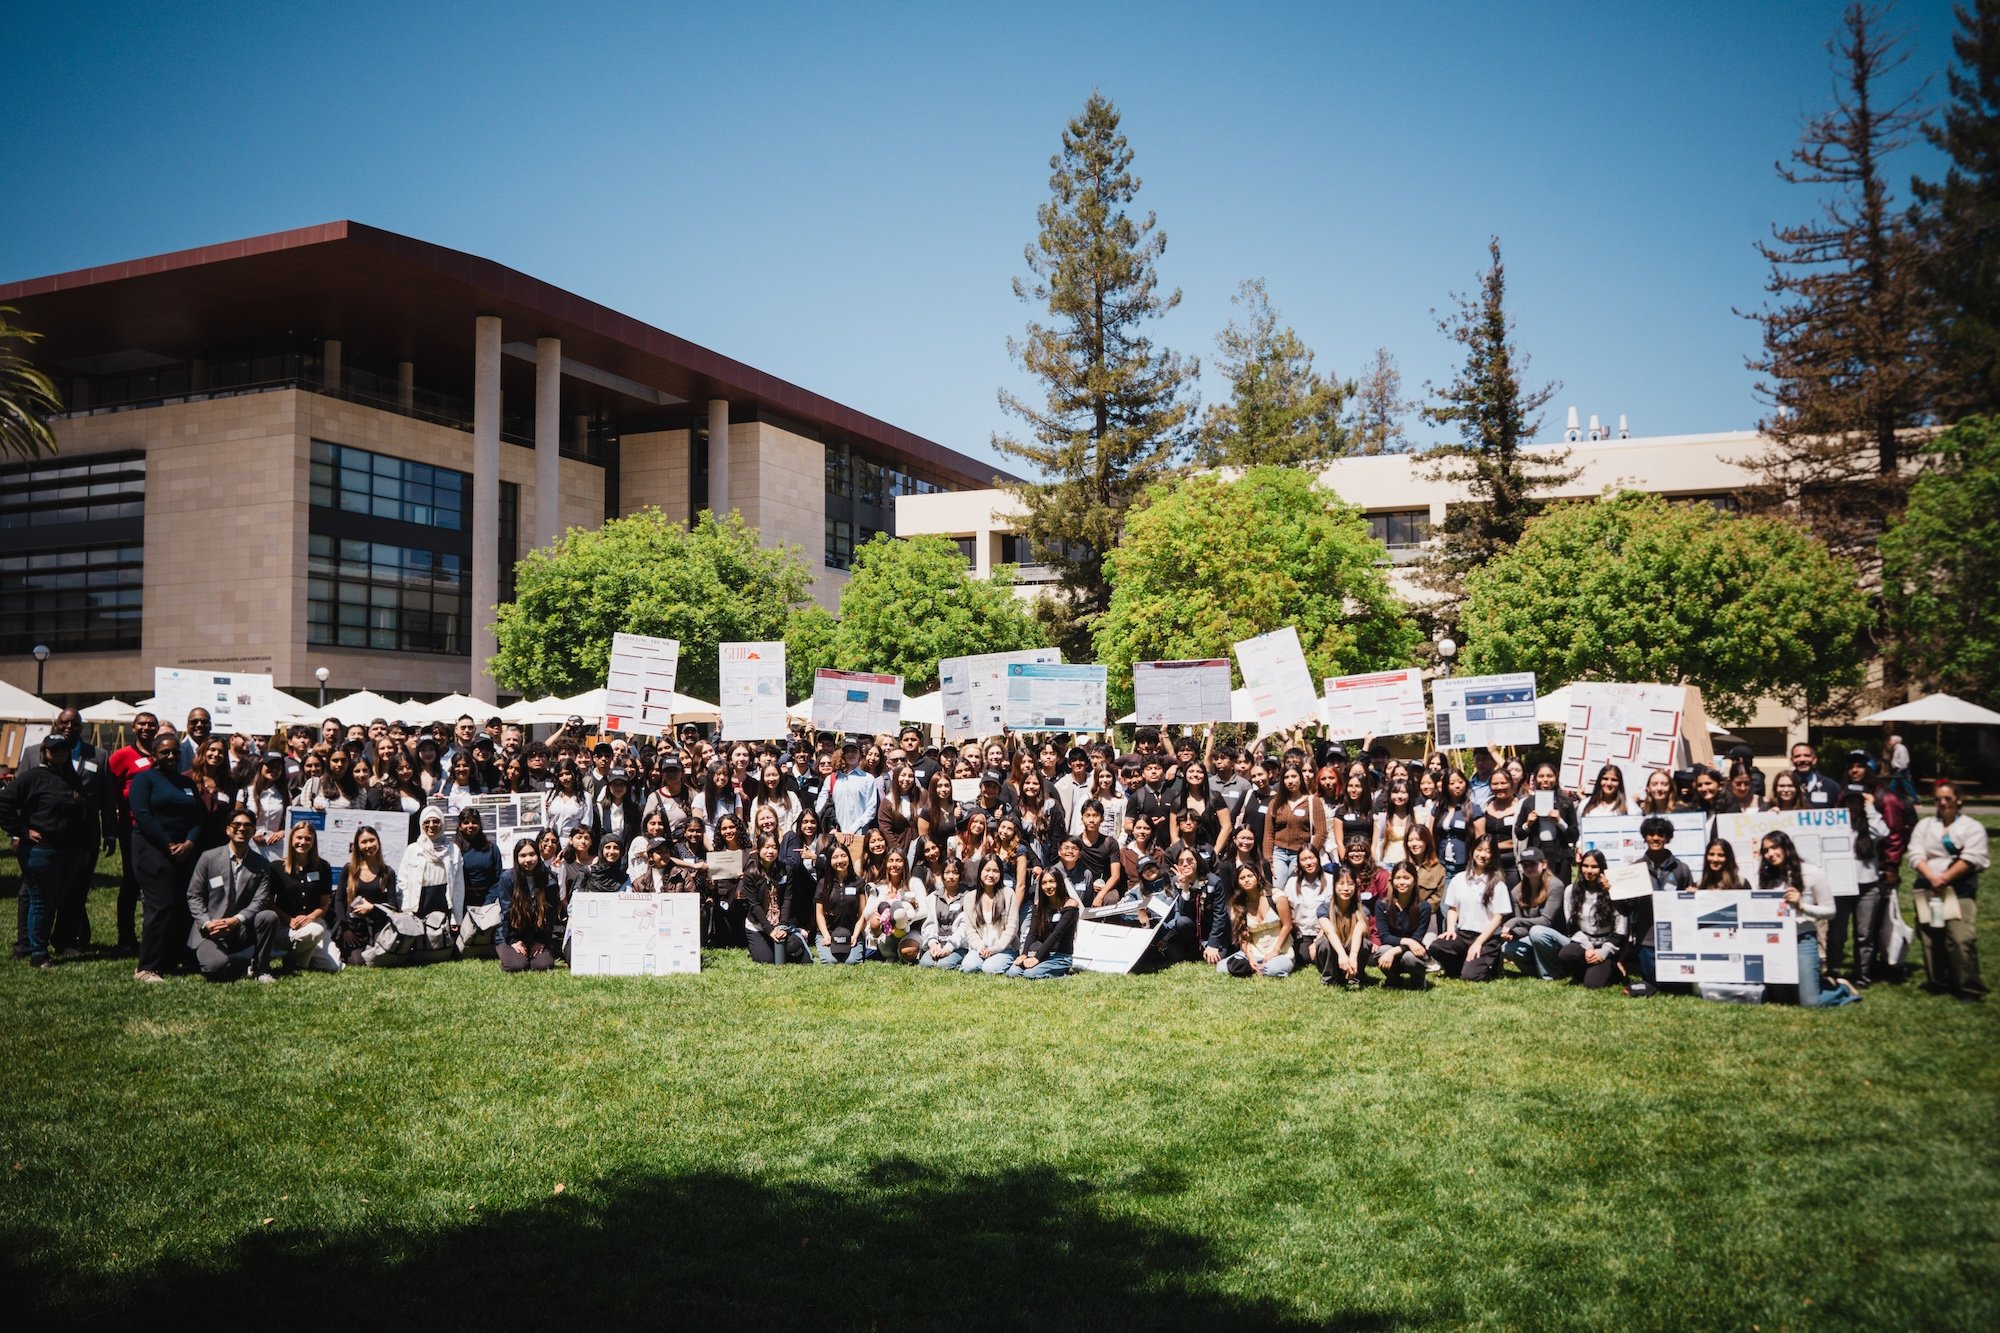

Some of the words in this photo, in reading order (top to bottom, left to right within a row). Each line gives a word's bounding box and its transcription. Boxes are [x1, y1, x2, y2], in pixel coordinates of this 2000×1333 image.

[724, 647, 750, 660] SHIP
[1732, 815, 1793, 836] Project
[1797, 809, 1848, 826] HUSH
